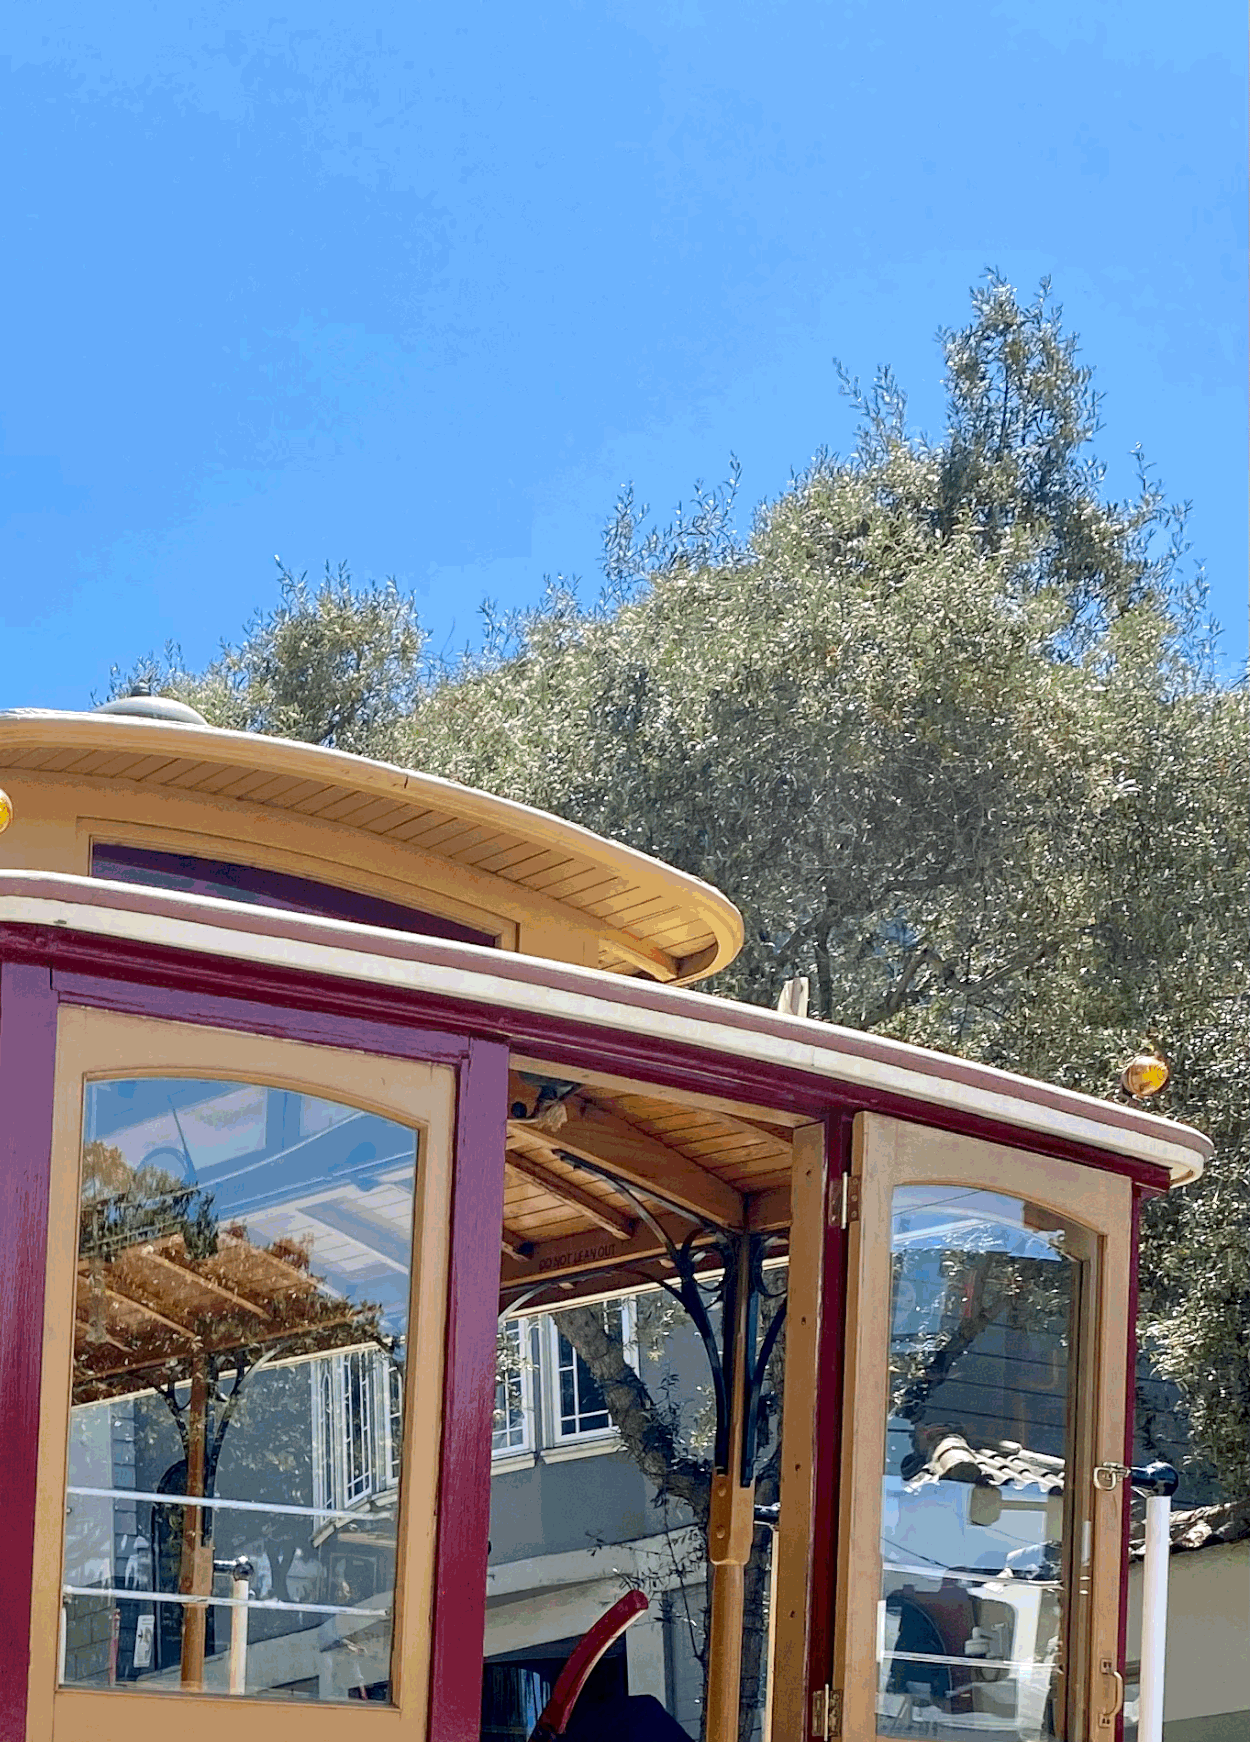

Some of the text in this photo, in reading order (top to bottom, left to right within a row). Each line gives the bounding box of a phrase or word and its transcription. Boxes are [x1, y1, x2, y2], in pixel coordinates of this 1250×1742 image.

[553, 1252, 572, 1269] NOT
[574, 1247, 596, 1264] LEAN
[598, 1242, 616, 1258] OUT
